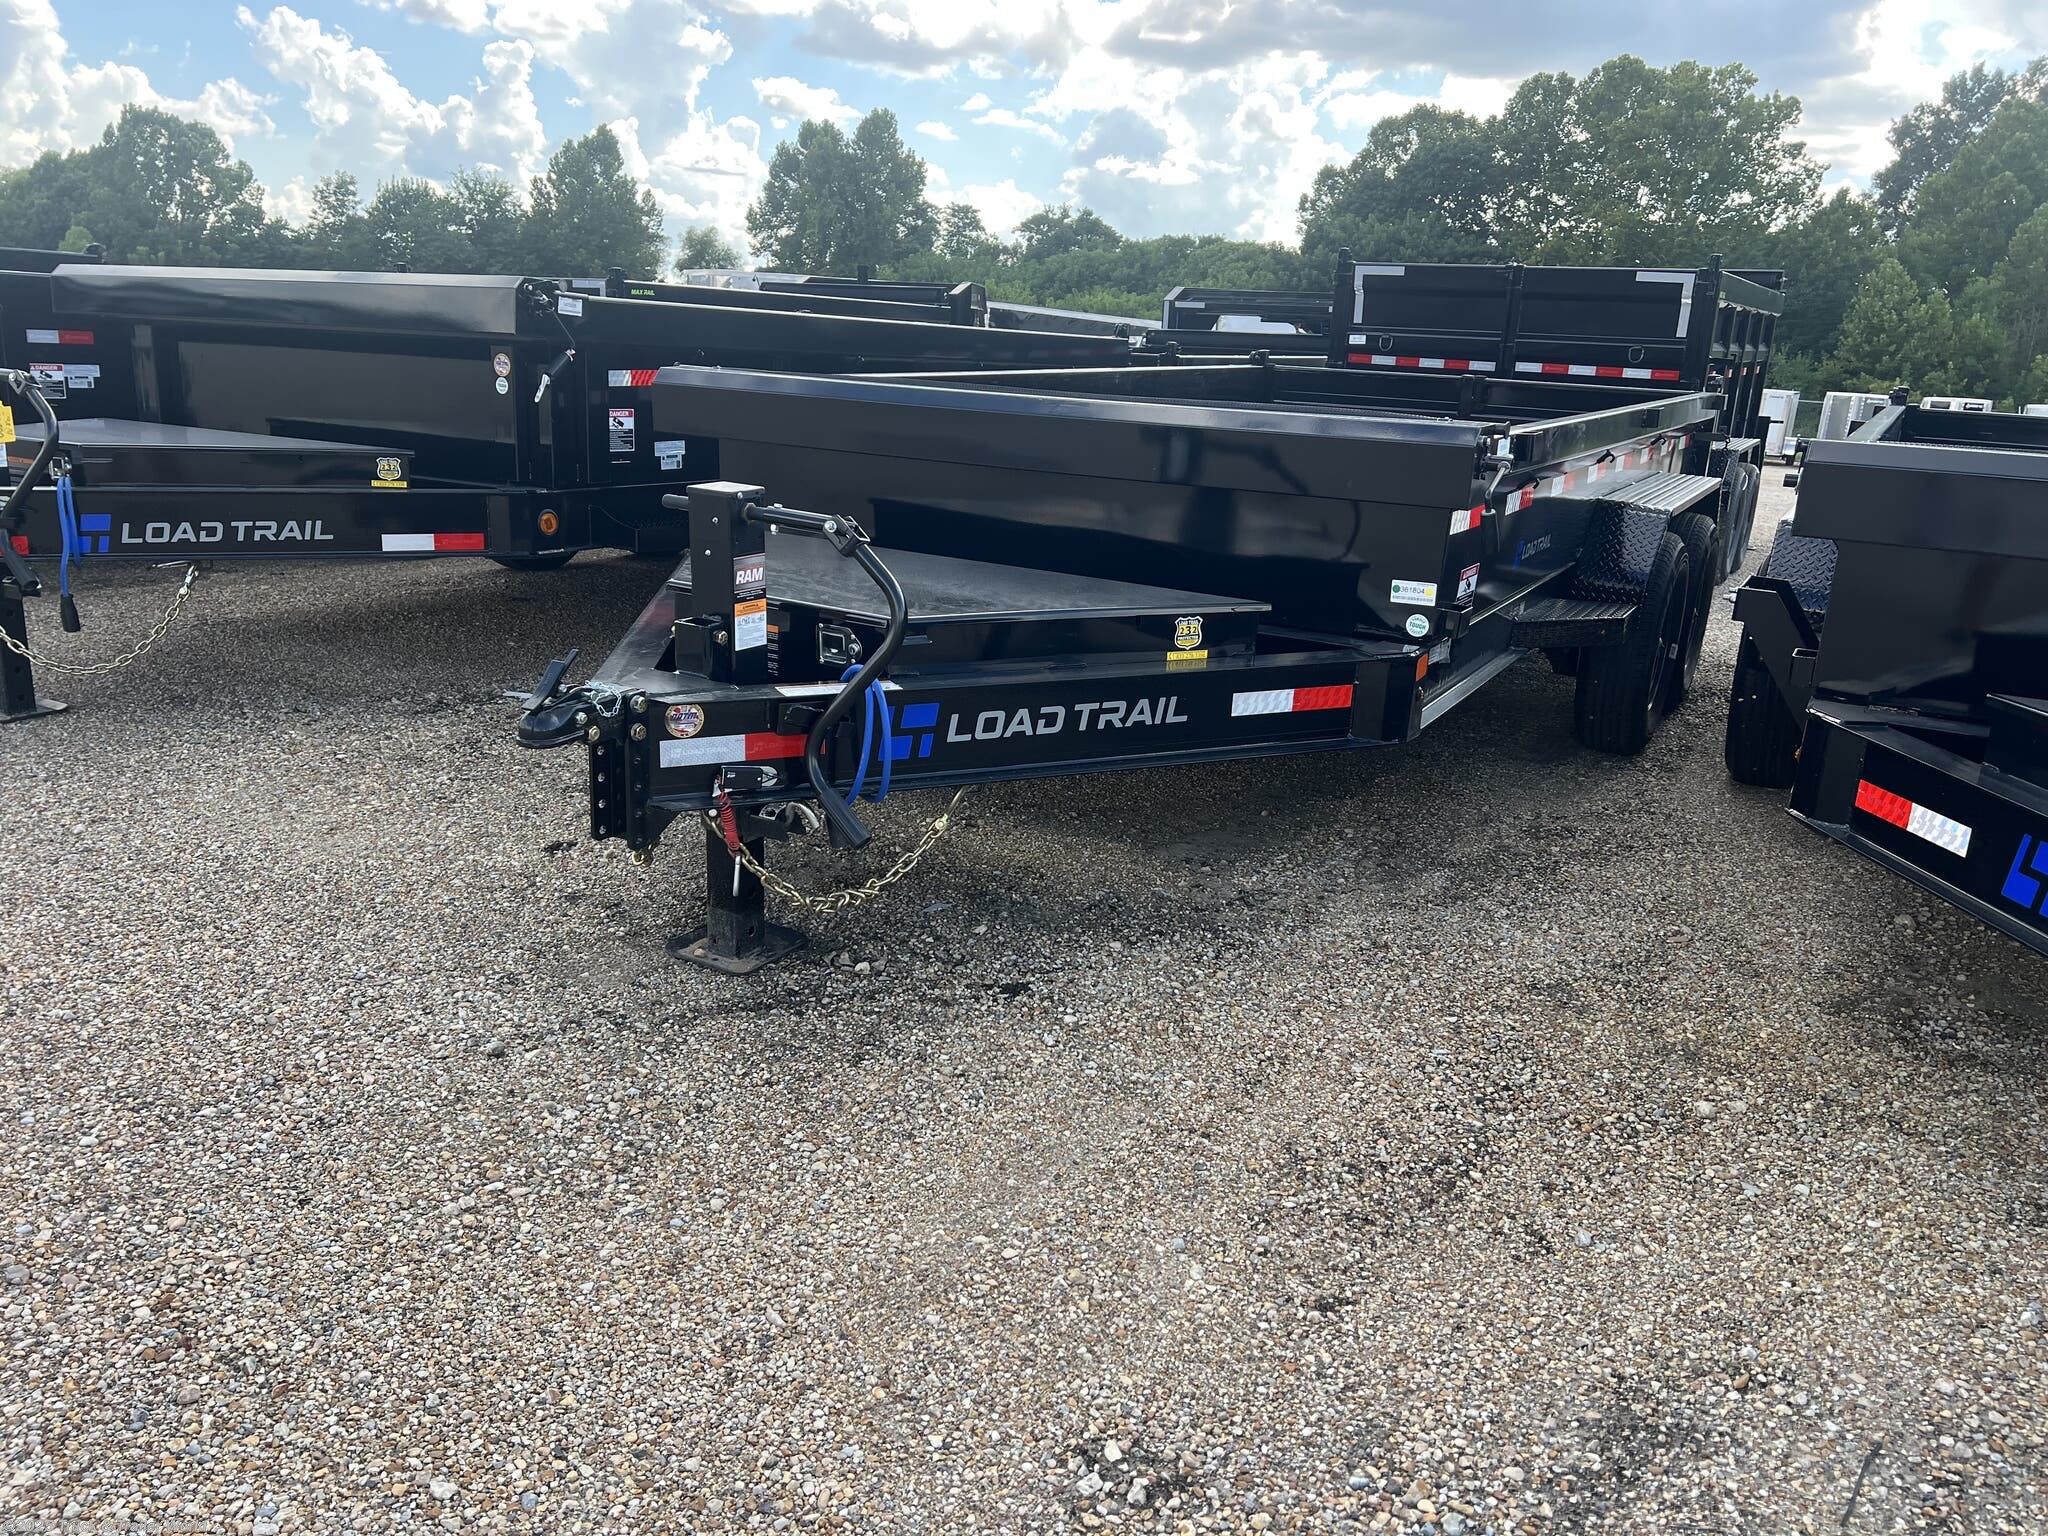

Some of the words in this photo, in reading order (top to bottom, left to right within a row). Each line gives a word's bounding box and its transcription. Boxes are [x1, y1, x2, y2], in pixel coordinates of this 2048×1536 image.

[121, 521, 224, 544] LOAD
[230, 519, 334, 542] TRAIL
[735, 567, 764, 585] RAM
[1180, 626, 1197, 635] 232
[946, 705, 1066, 743] LOAD
[1074, 695, 1188, 732] TRAIL
